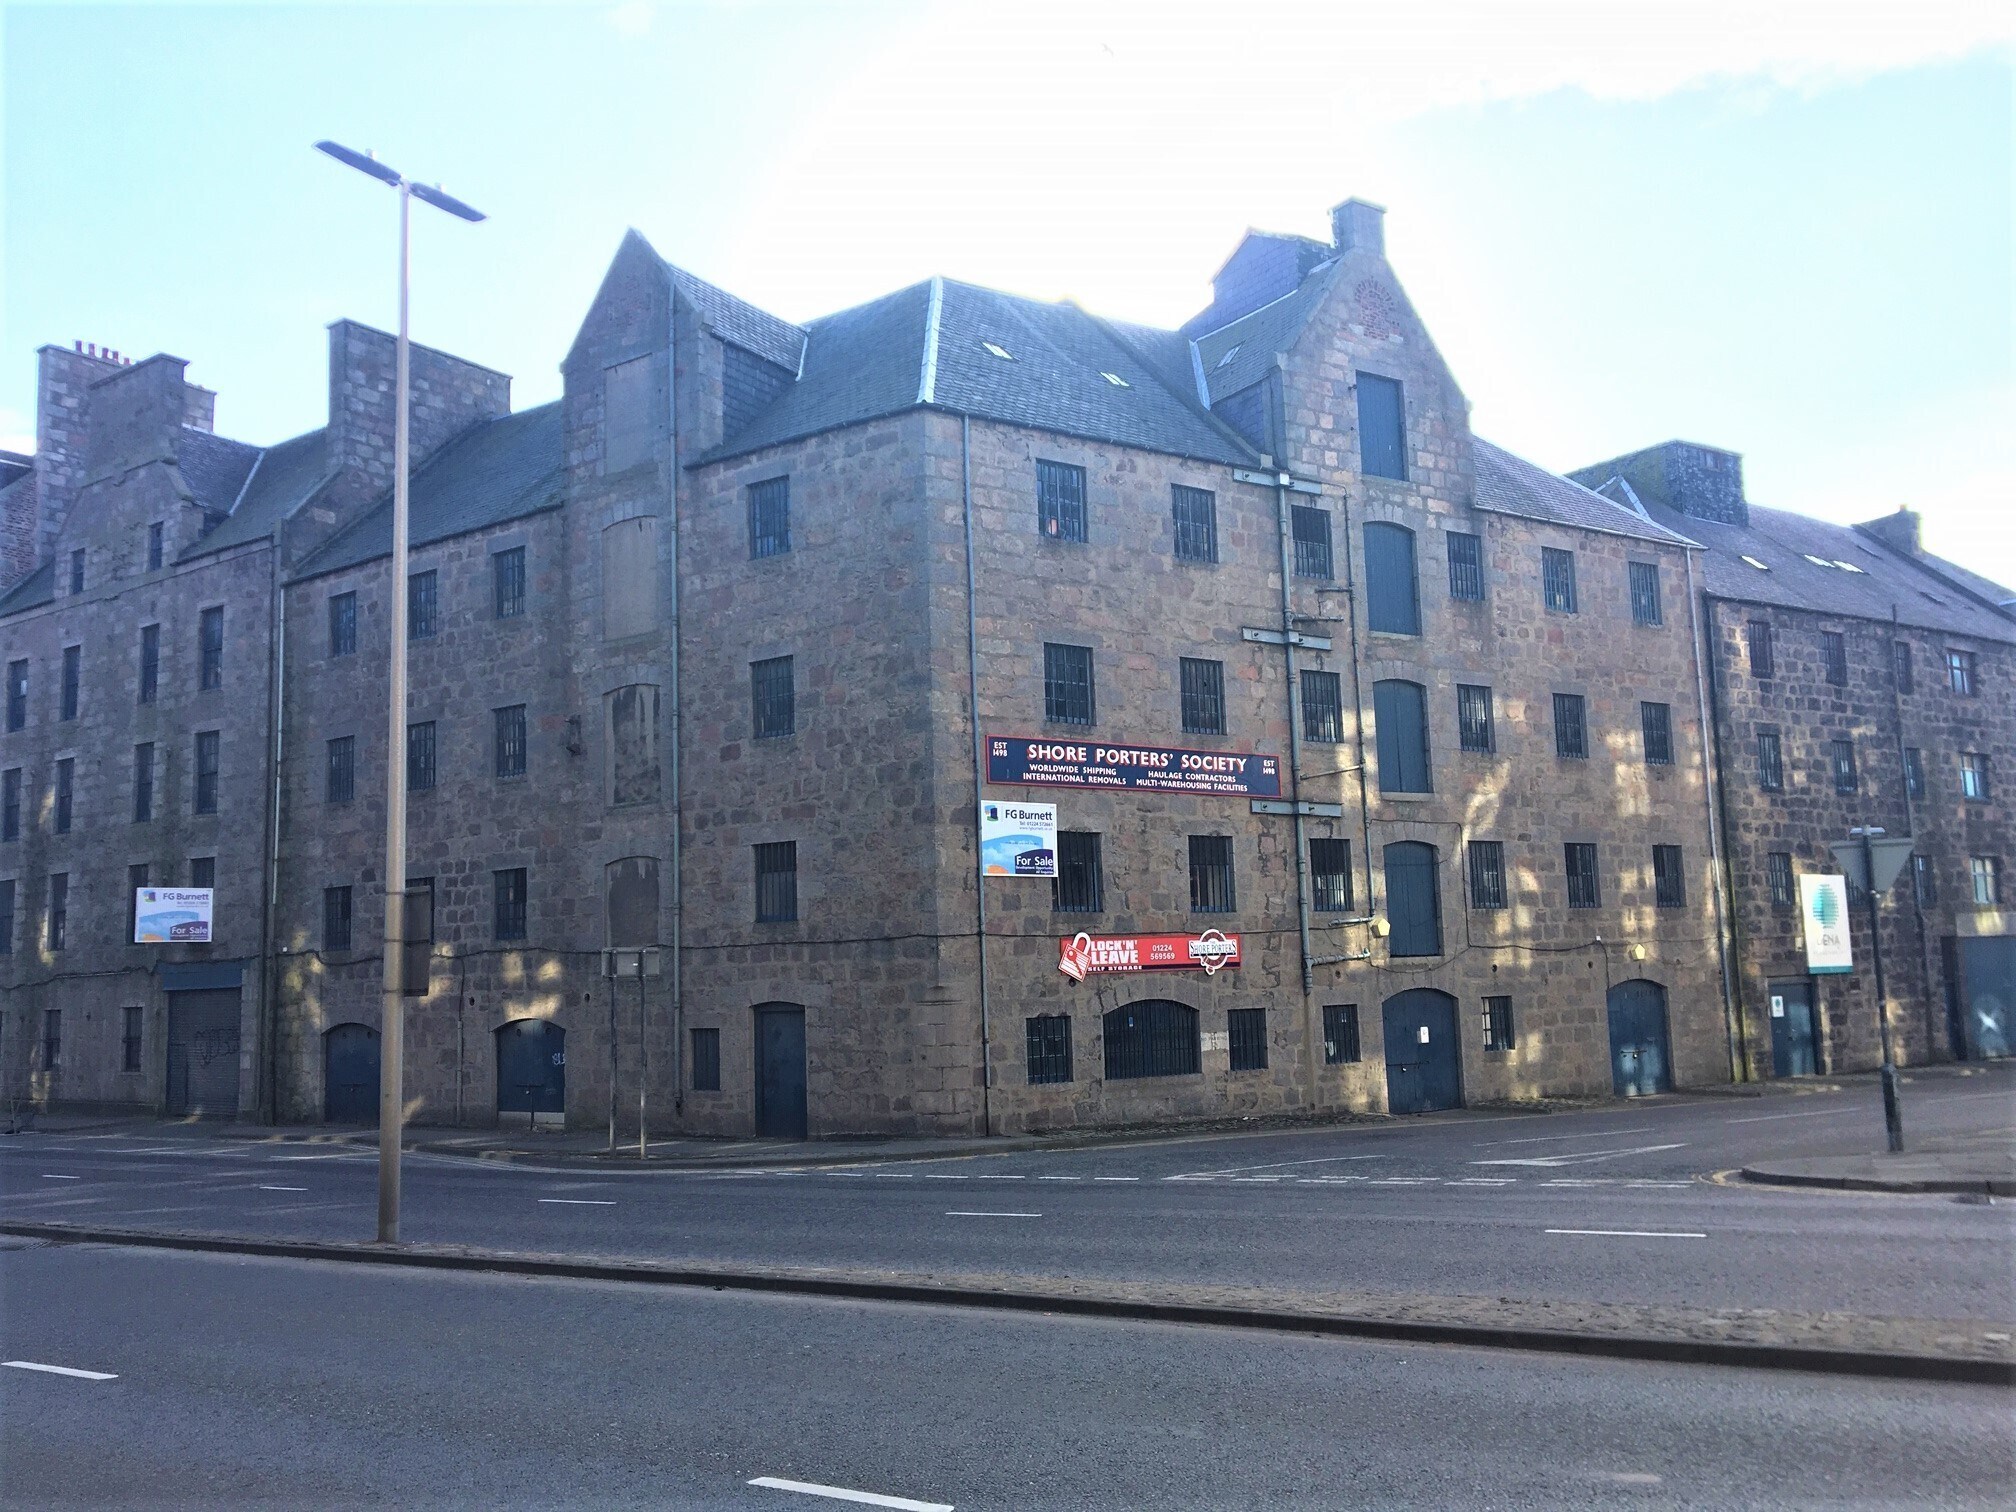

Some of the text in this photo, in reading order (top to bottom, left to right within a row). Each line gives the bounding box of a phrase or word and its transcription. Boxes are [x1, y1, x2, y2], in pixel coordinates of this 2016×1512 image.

[994, 741, 1008, 749] EST
[993, 749, 1008, 757] 1498
[1028, 744, 1087, 762] SHORE
[1181, 754, 1248, 772] SOCIETY
[1263, 759, 1275, 767] EST
[1029, 764, 1117, 776] WORLDWIDE SHIPPING
[1263, 767, 1276, 775] 1498
[1023, 772, 1127, 785] INTERNATIONAL REMOVALS
[1148, 771, 1236, 783] HAULAGE CONTRACTORS
[1136, 778, 1248, 792] MULTI-WAREHOUSING FACILITIES
[1005, 809, 1053, 821] FG Burnett
[1016, 855, 1054, 866] For Sale
[176, 893, 209, 901] Burnett
[171, 926, 208, 934] For Sale
[1152, 944, 1173, 952] 01224
[1190, 941, 1210, 954] SHORE
[1091, 950, 1139, 965] LEAVE
